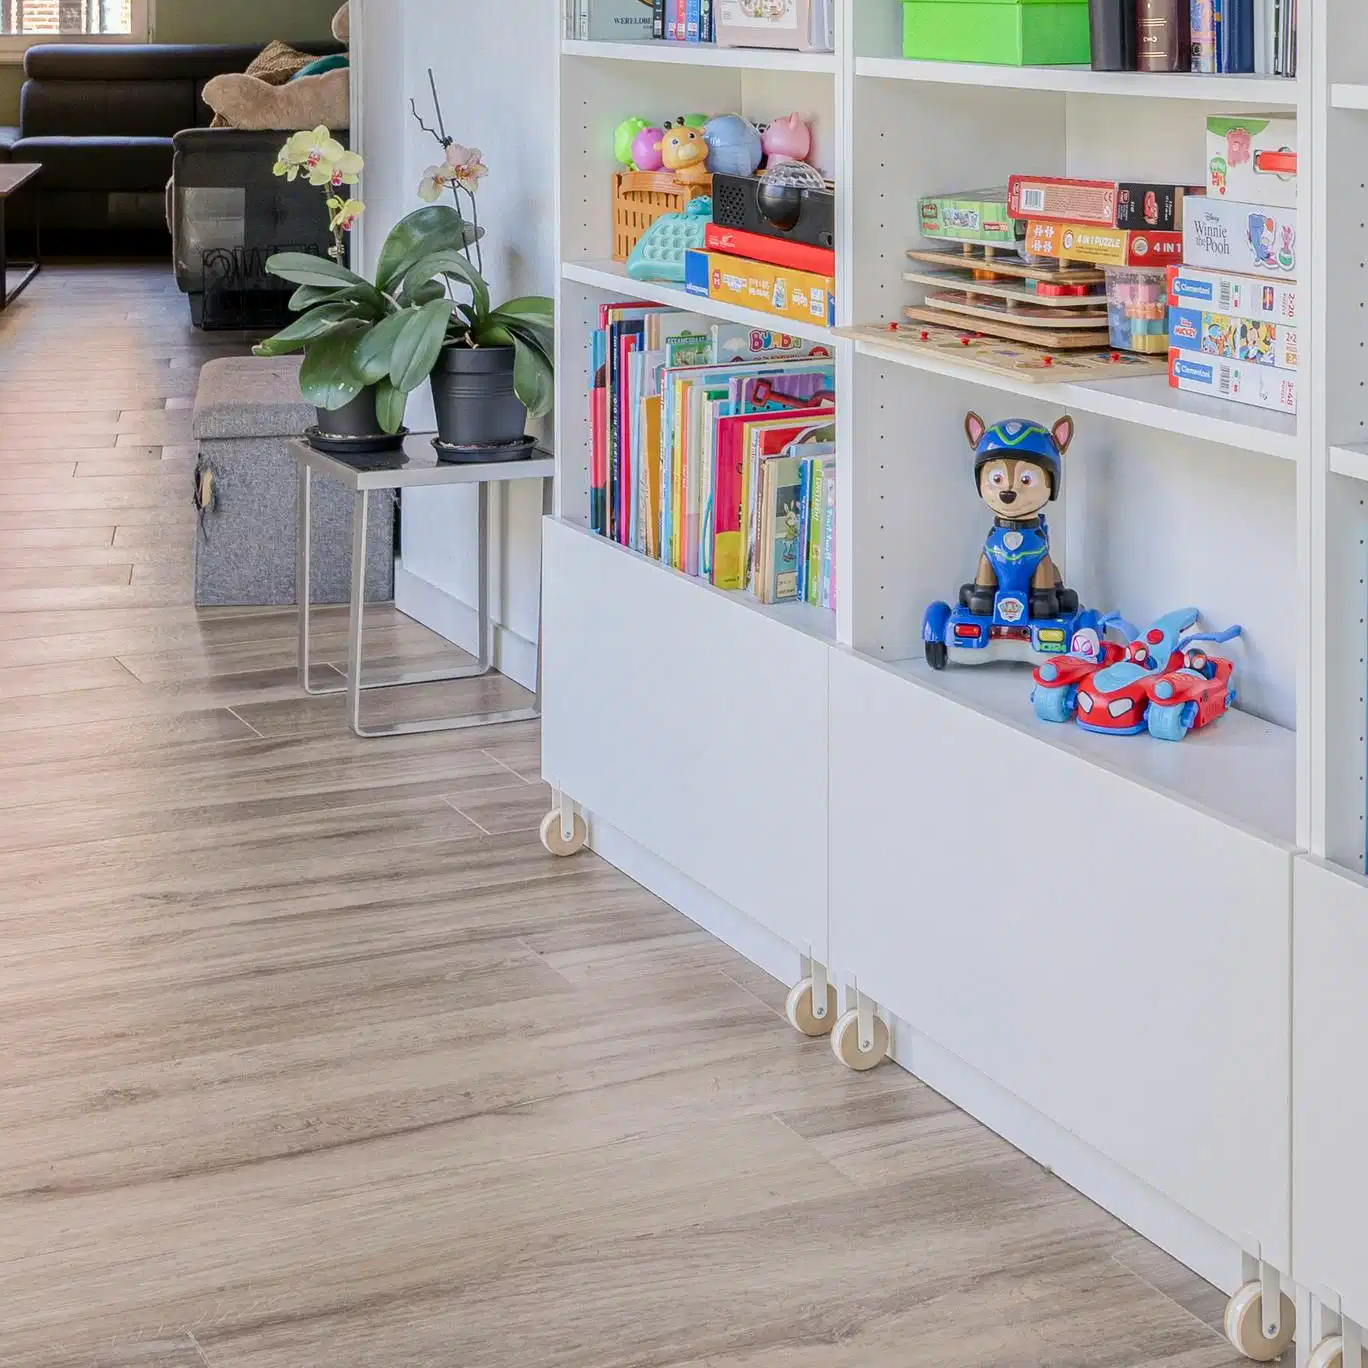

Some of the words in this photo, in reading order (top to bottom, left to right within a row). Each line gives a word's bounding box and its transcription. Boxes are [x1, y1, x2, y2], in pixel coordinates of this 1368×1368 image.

[1194, 220, 1227, 238] Winnie
[1205, 237, 1230, 255] Pooh
[1181, 284, 1210, 295] Clementoni
[1181, 366, 1211, 378] Clementoni
